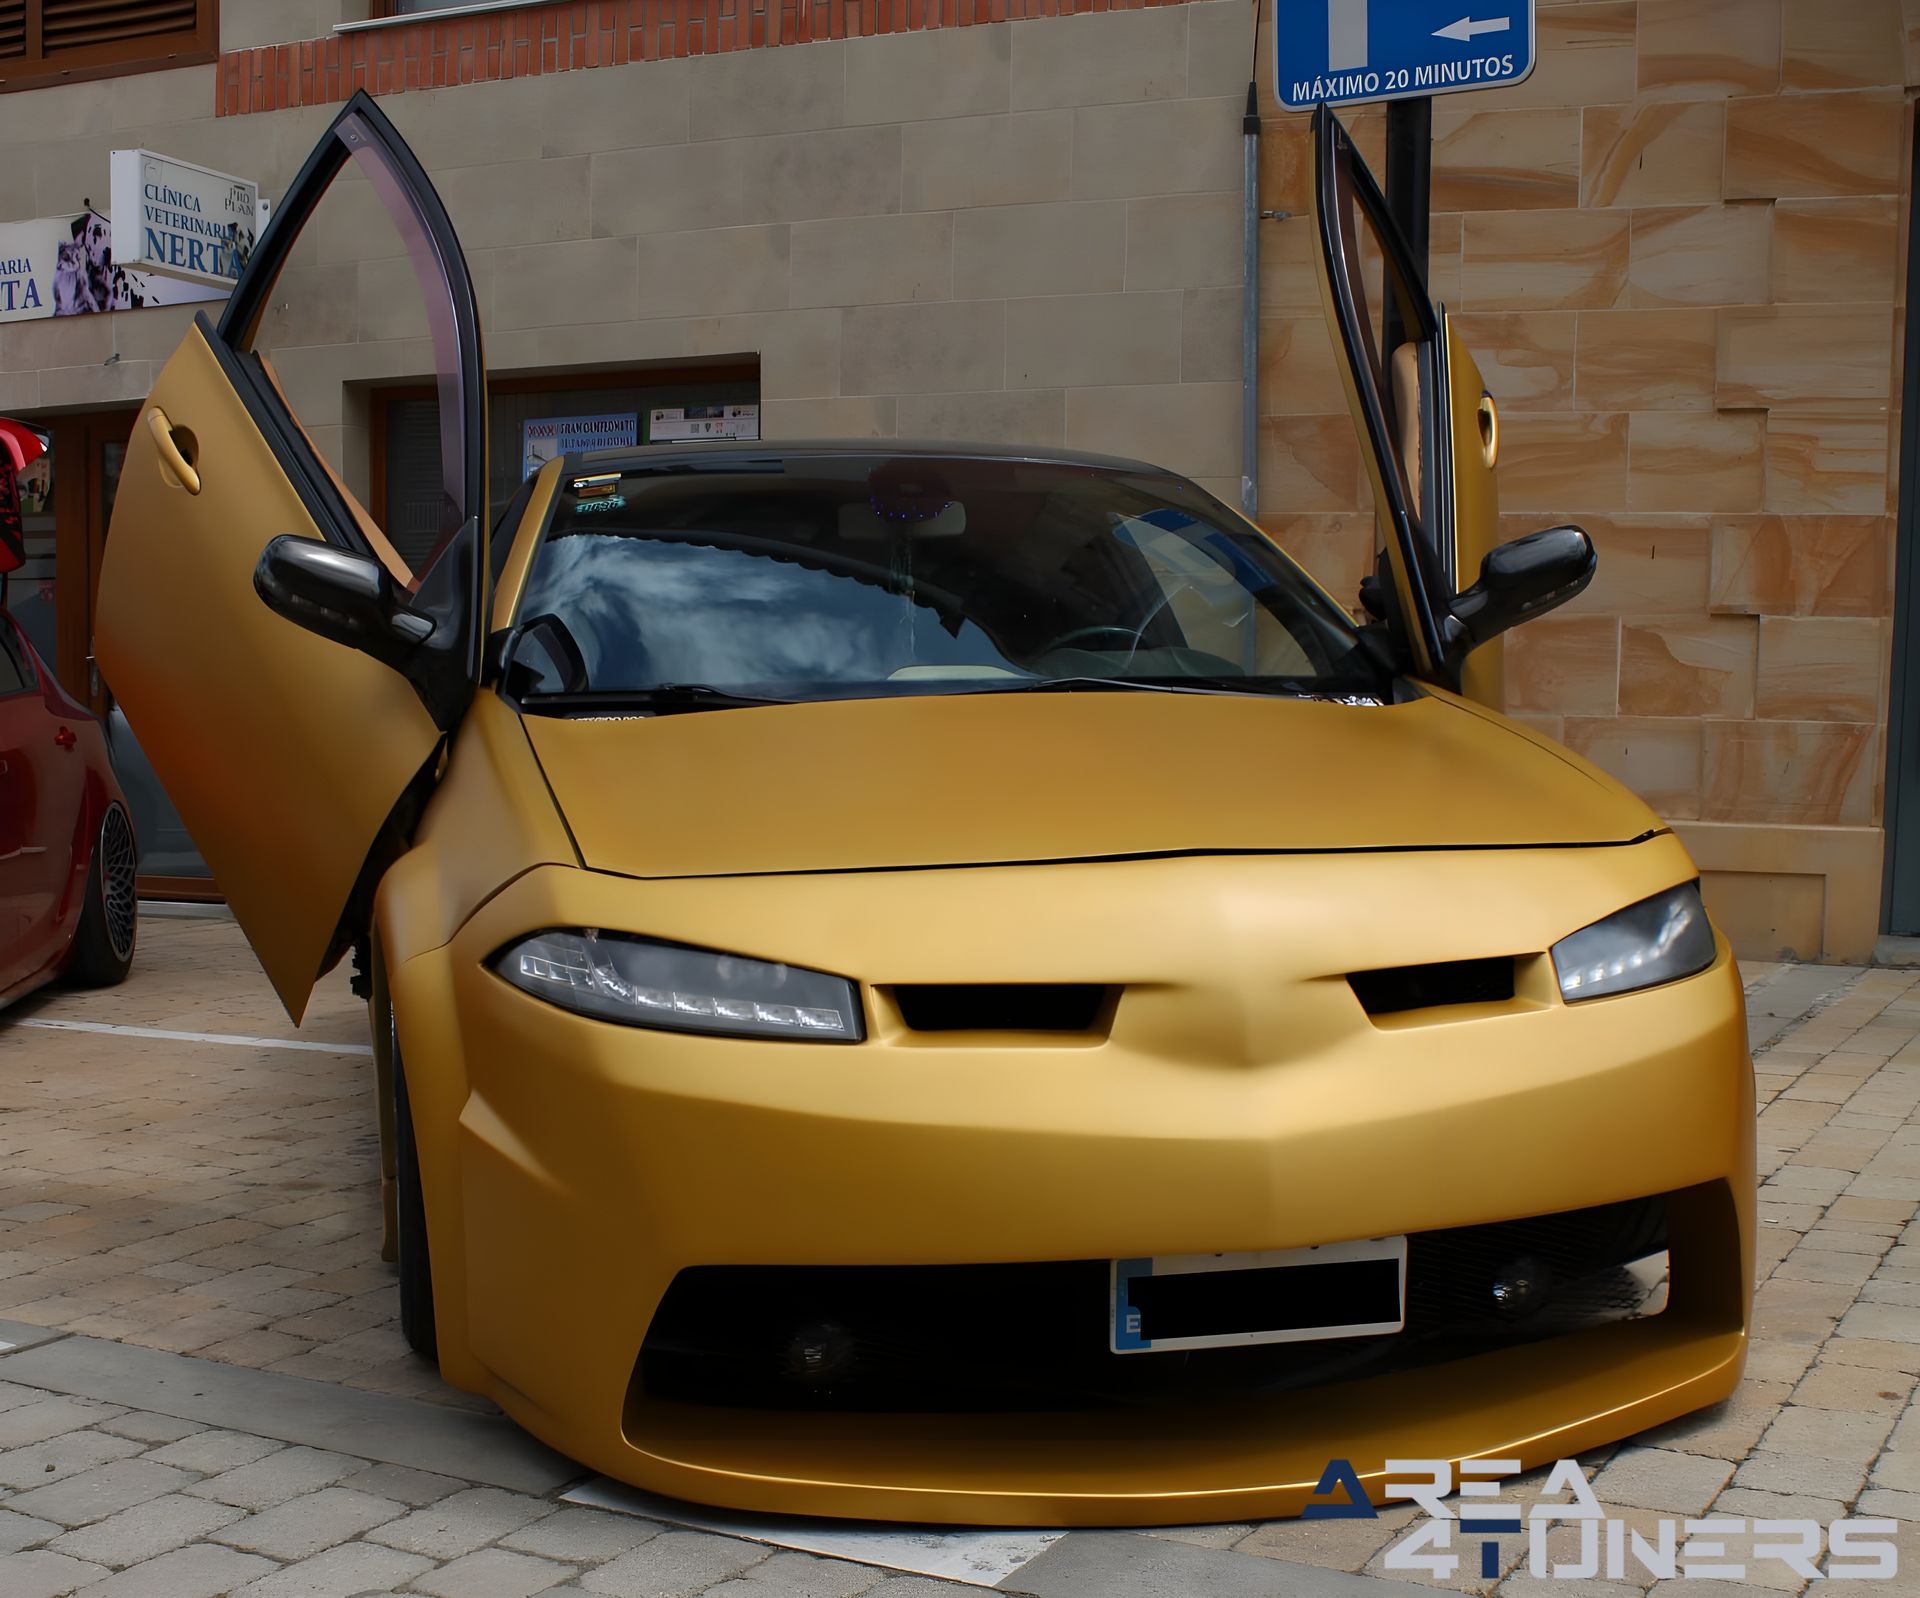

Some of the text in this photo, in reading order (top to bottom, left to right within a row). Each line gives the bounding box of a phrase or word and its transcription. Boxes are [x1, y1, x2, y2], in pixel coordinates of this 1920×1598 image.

[1292, 54, 1514, 102] MÁXIMO 20 MINUTOS
[144, 183, 202, 213] CLÍNICA
[144, 226, 245, 280] NERTA
[0, 278, 43, 312] TA
